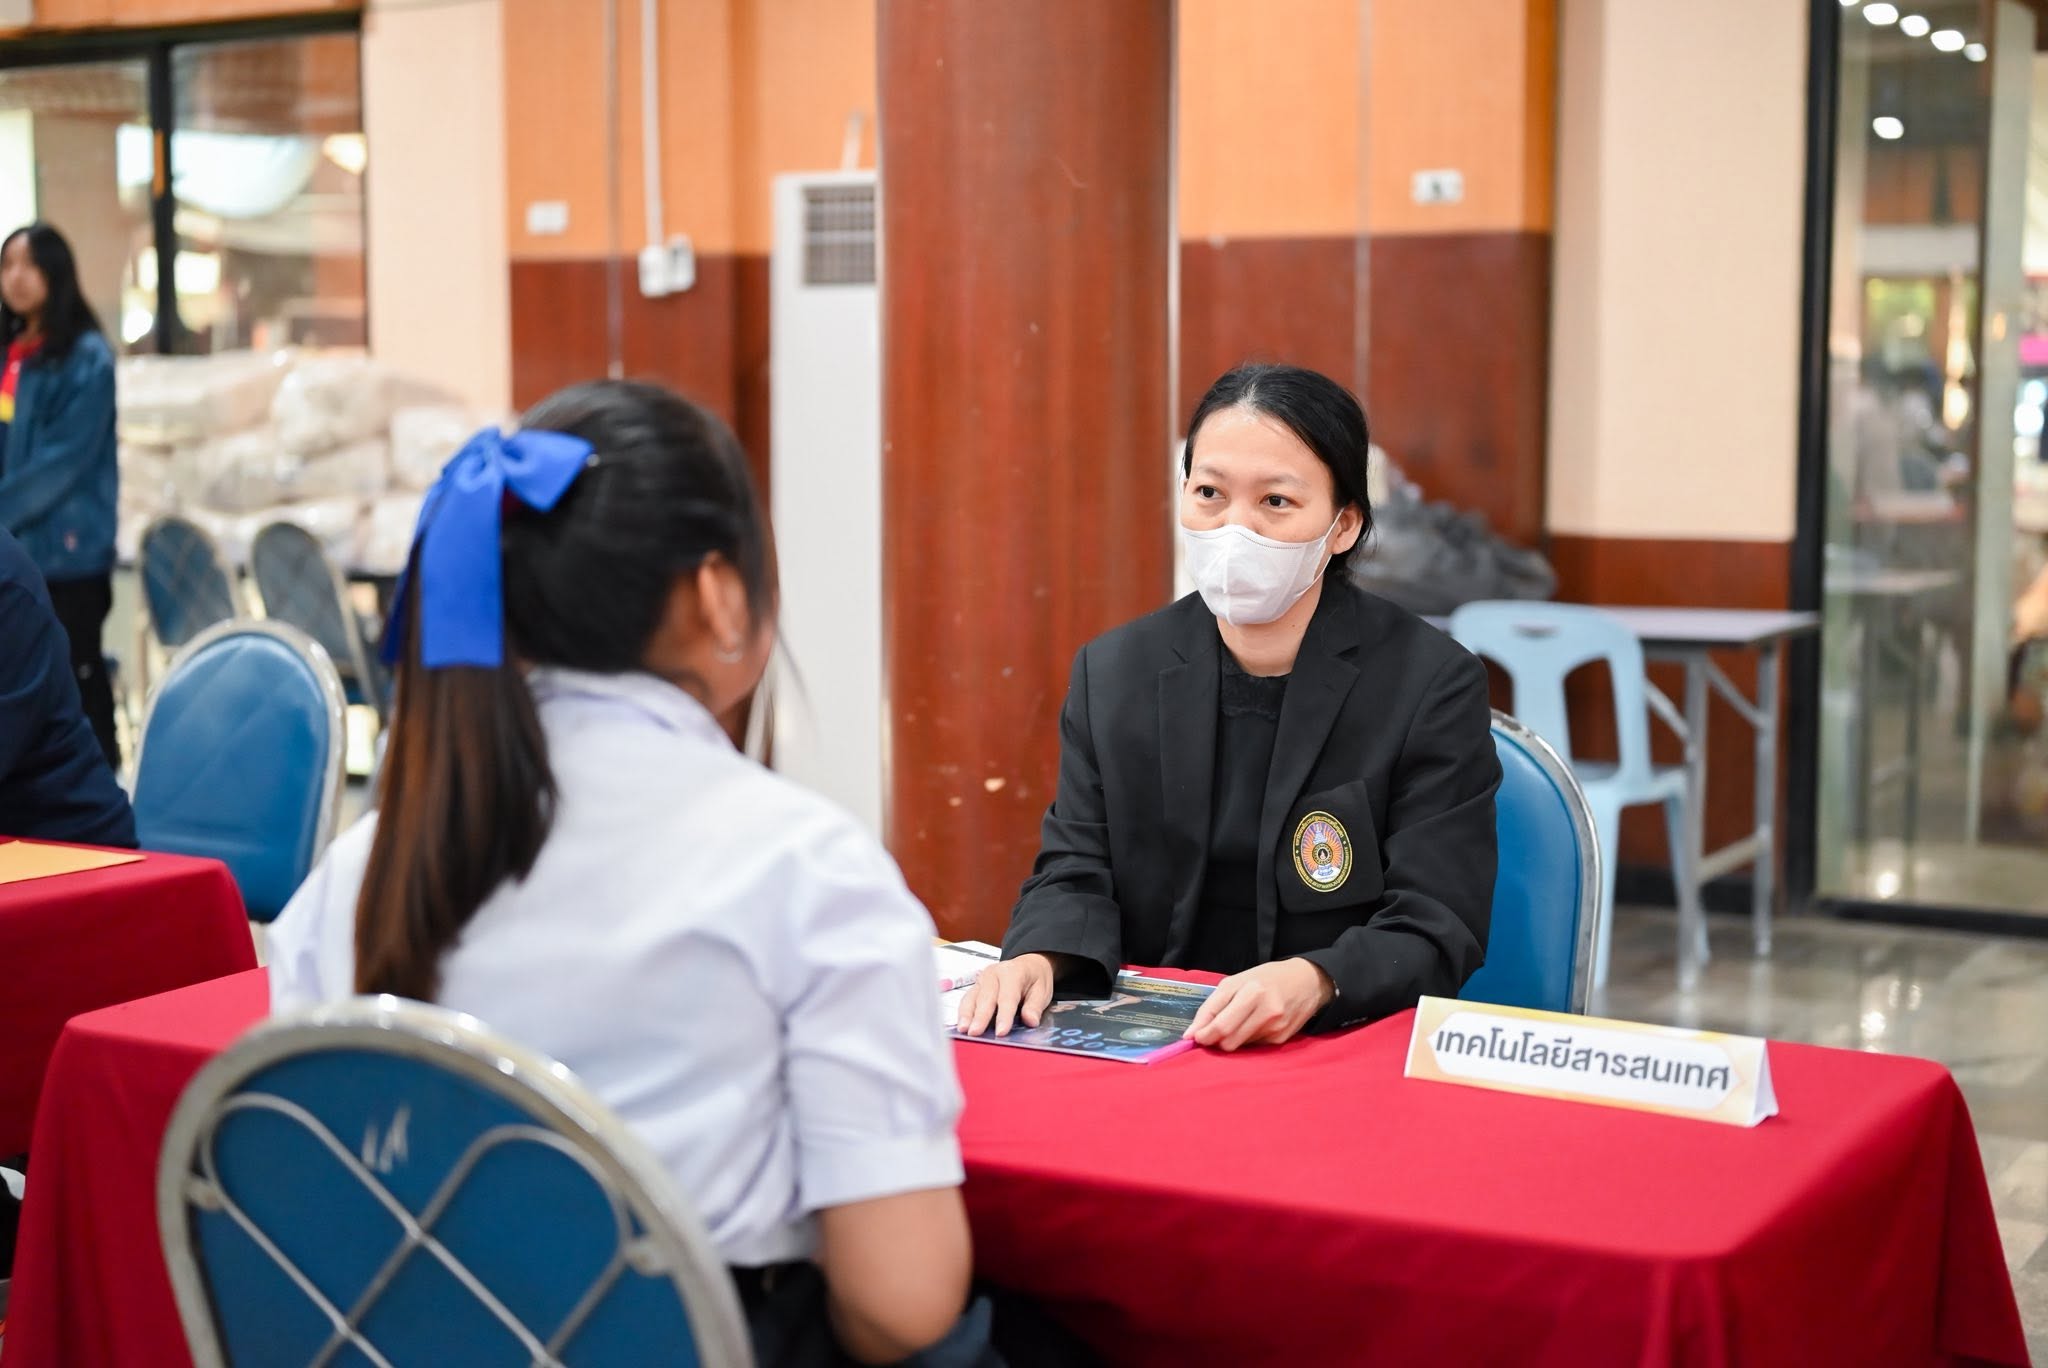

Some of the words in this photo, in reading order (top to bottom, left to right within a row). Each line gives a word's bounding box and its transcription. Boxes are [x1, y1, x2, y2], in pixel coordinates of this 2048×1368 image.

[1435, 1027, 1729, 1091] เทคโนโลยีสารสนเทศ
